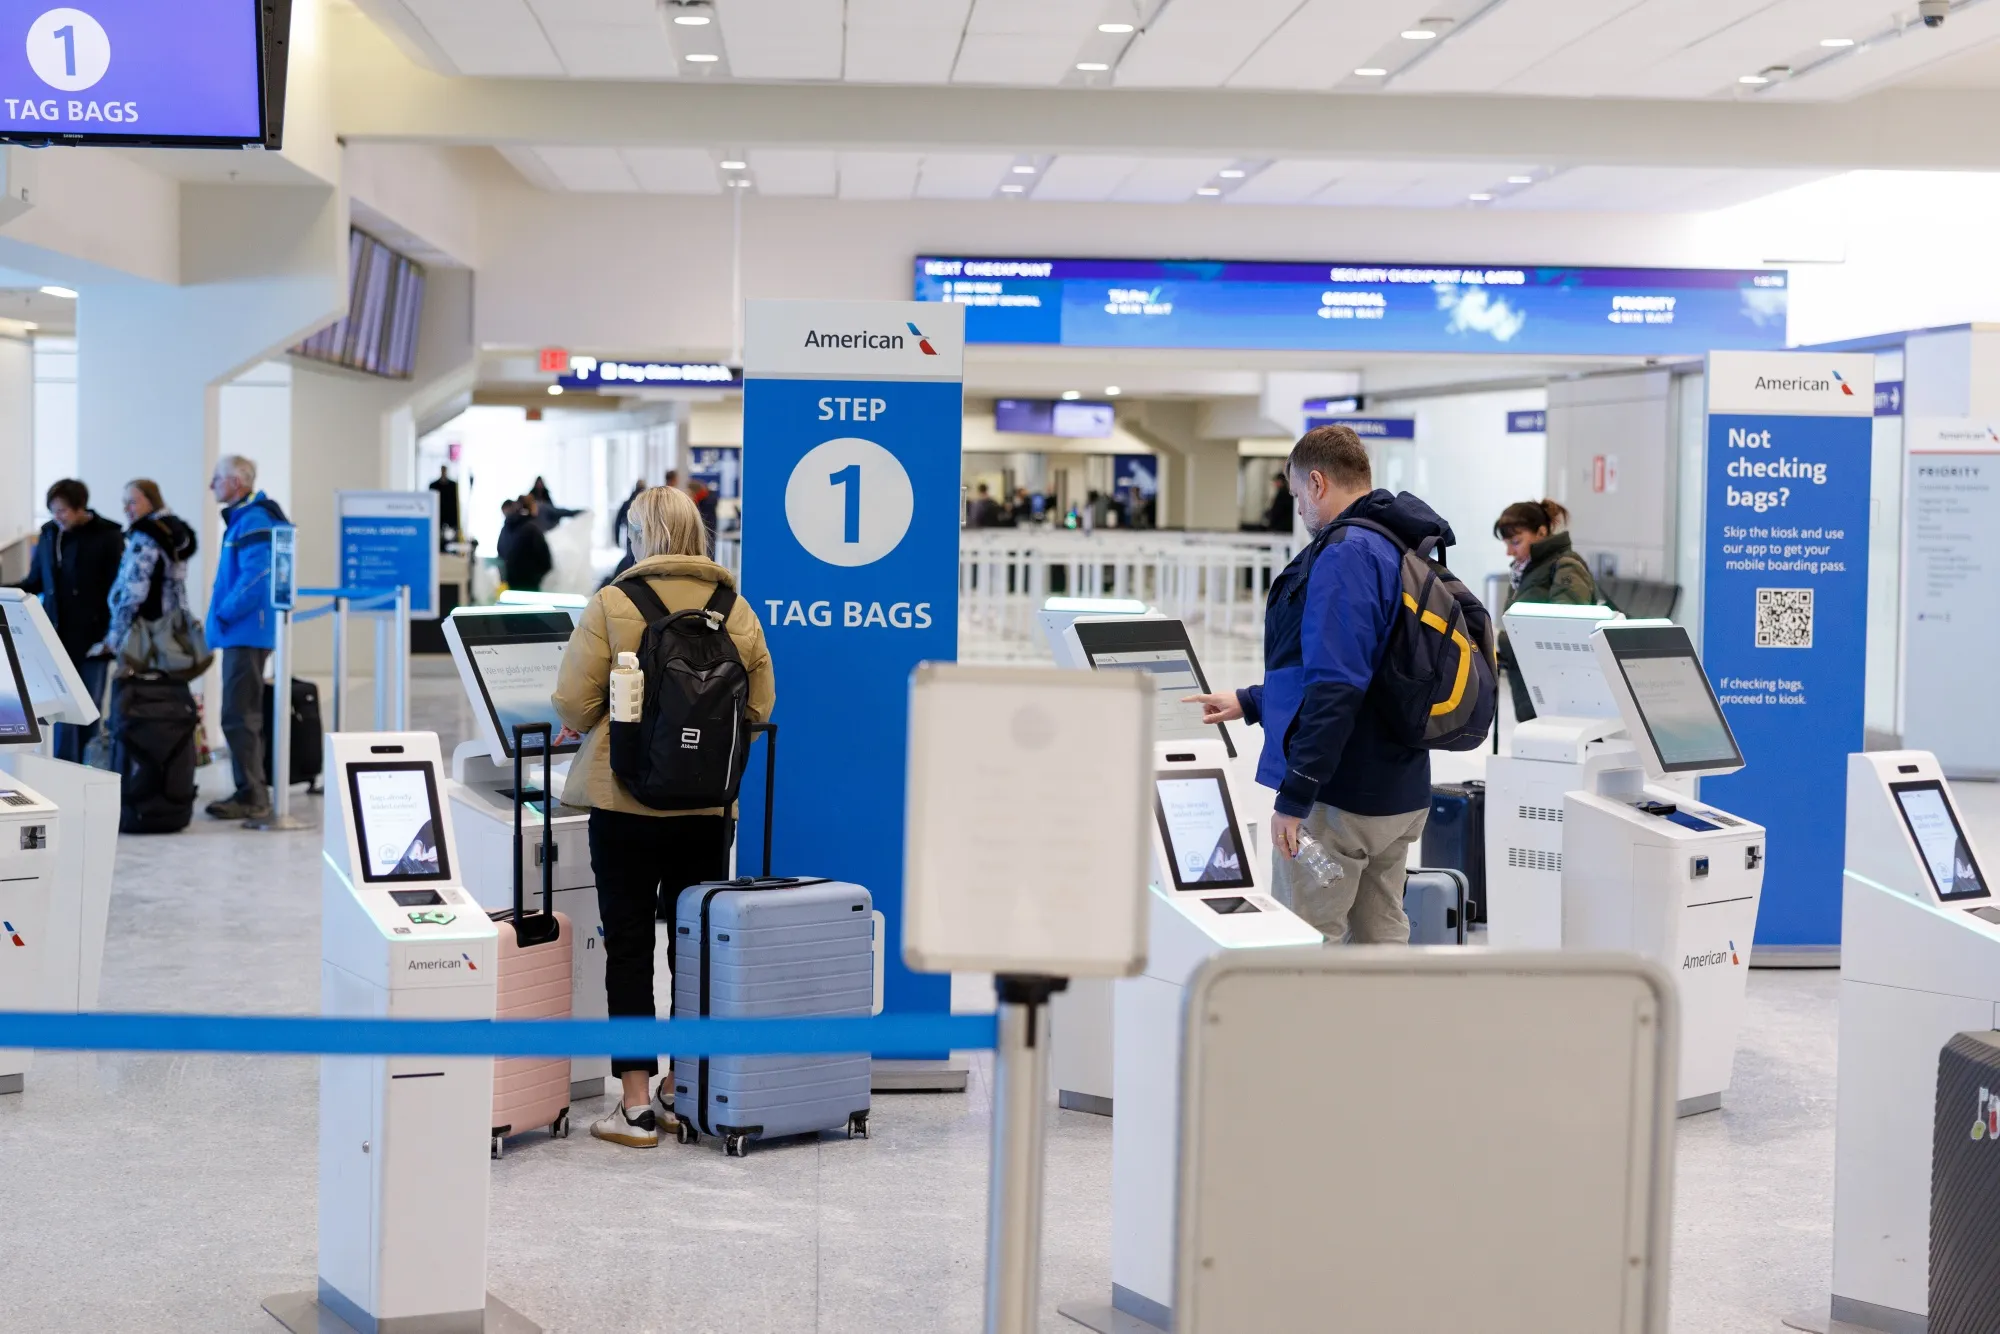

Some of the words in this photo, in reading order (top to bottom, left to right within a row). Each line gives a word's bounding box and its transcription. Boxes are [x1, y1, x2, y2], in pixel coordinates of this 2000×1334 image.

[53, 25, 76, 76] 1
[5, 99, 59, 121] TAG
[68, 101, 139, 123] BAGS
[963, 262, 1052, 277] CHECKPOINT
[1612, 296, 1676, 311] PRIORITY
[804, 330, 904, 350] American
[1755, 376, 1830, 391] American
[818, 397, 887, 422] STEP
[1728, 428, 1771, 449] Not
[1727, 457, 1827, 485] checking
[1919, 466, 1980, 478] PRIORITY
[829, 464, 861, 543] 1
[1727, 486, 1790, 513] bags?
[1723, 525, 1747, 540] Skip
[1749, 526, 1769, 538] the
[1771, 526, 1798, 539] kiosk
[1800, 528, 1822, 539] and
[1824, 530, 1845, 539] use
[1723, 545, 1744, 554] our
[1745, 545, 1767, 557] app
[1769, 543, 1781, 555] to
[1784, 544, 1802, 558] get
[1804, 545, 1830, 558] your
[1725, 559, 1765, 571] mobile
[1767, 559, 1818, 574] boarding
[1820, 562, 1847, 574] pass.
[765, 600, 832, 626] TAG
[843, 602, 932, 628] BAGS
[1720, 677, 1729, 689] If
[1729, 677, 1776, 692] checking
[1720, 693, 1762, 706] proceed
[1764, 694, 1777, 704] to
[408, 958, 461, 970] American
[1682, 949, 1727, 970] American
